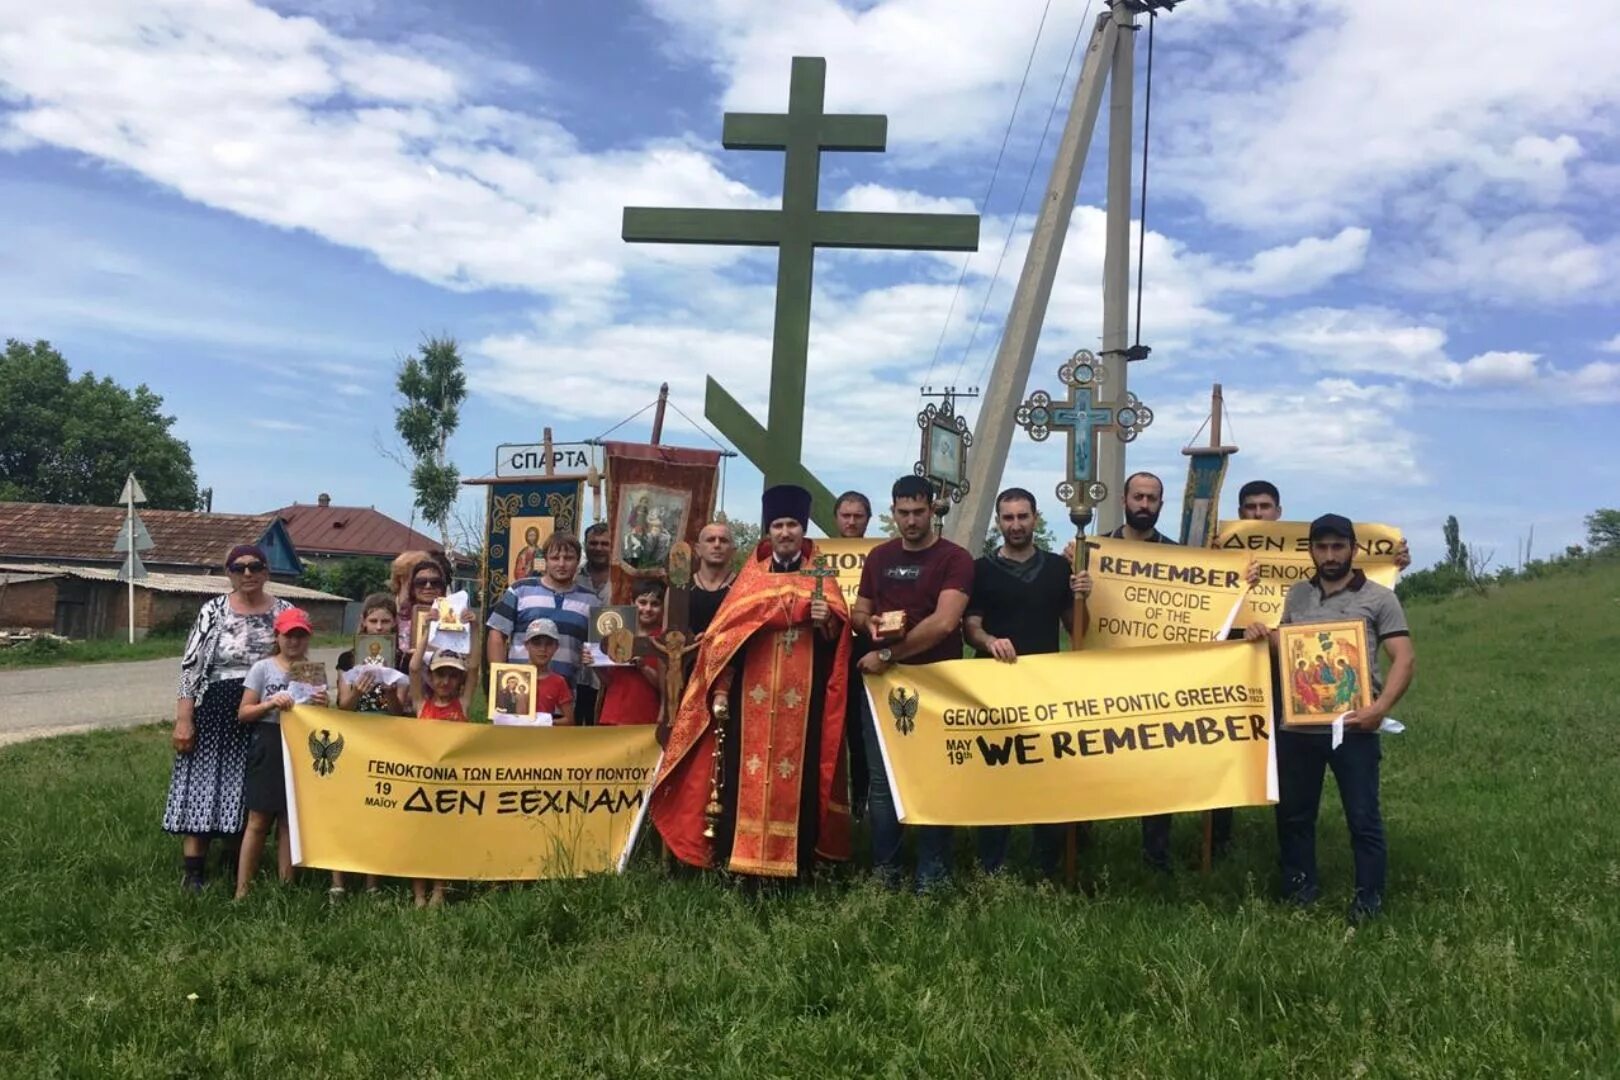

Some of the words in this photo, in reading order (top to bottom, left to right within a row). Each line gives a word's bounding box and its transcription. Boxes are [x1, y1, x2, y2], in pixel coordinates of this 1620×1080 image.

[511, 451, 588, 469] СПАРТА
[1223, 533, 1285, 552] ΔΕΝ
[1100, 555, 1240, 588] REMEMBER
[1124, 586, 1211, 611] GENOCIDE
[1145, 606, 1163, 620] OF
[1167, 609, 1191, 624] THE
[1099, 617, 1158, 640] PONTIC
[943, 705, 1031, 726] GENOCIDE
[1034, 704, 1058, 721] OF
[1063, 699, 1100, 718] THE
[1104, 691, 1170, 715] PONTIC
[1175, 684, 1248, 707] GREEKS
[946, 739, 973, 751] MAY
[976, 733, 1044, 766] WE
[1051, 714, 1269, 759] REMEMBER
[947, 751, 973, 765] 19th
[368, 760, 458, 780] ΓΕΝΟΚΤΟΝΙΑ
[462, 768, 491, 781] ΤΩΝ
[496, 767, 562, 780] ΕΛΛΗΝΩΝ
[596, 767, 648, 780] ΠΟΝΤΟΥ
[375, 781, 392, 795] 19
[403, 786, 486, 816] ΔΕΝ
